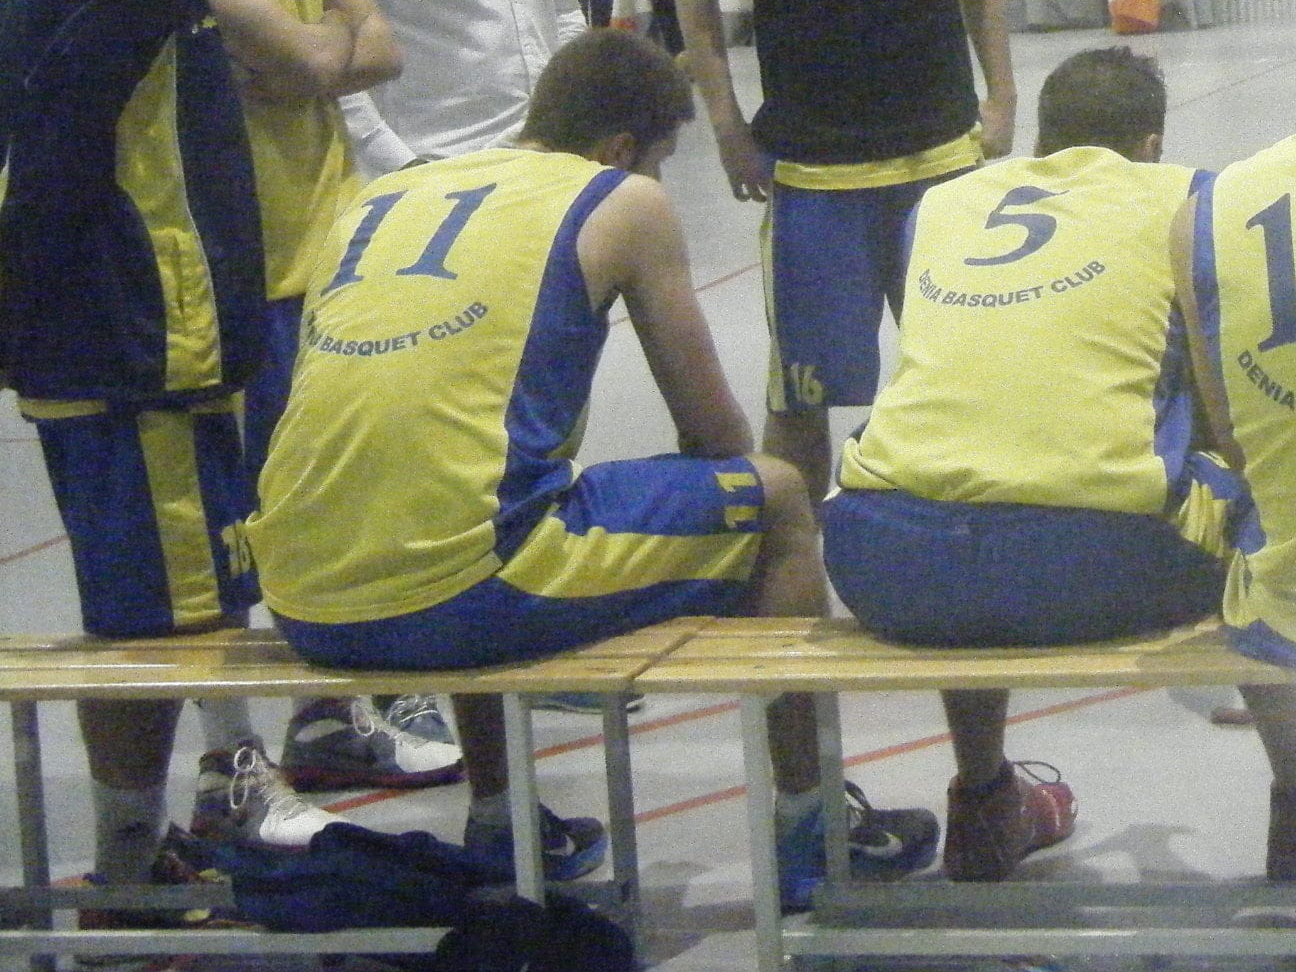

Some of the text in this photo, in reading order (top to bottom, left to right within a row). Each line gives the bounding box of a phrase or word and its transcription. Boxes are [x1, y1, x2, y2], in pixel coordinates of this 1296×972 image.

[320, 182, 497, 298] 11
[963, 185, 1070, 266] 5
[918, 260, 1106, 308] DENIA BASQUET CLUB
[319, 301, 489, 357] BASQUET CLUB
[790, 363, 824, 405] 16
[1237, 350, 1296, 412] DENIA
